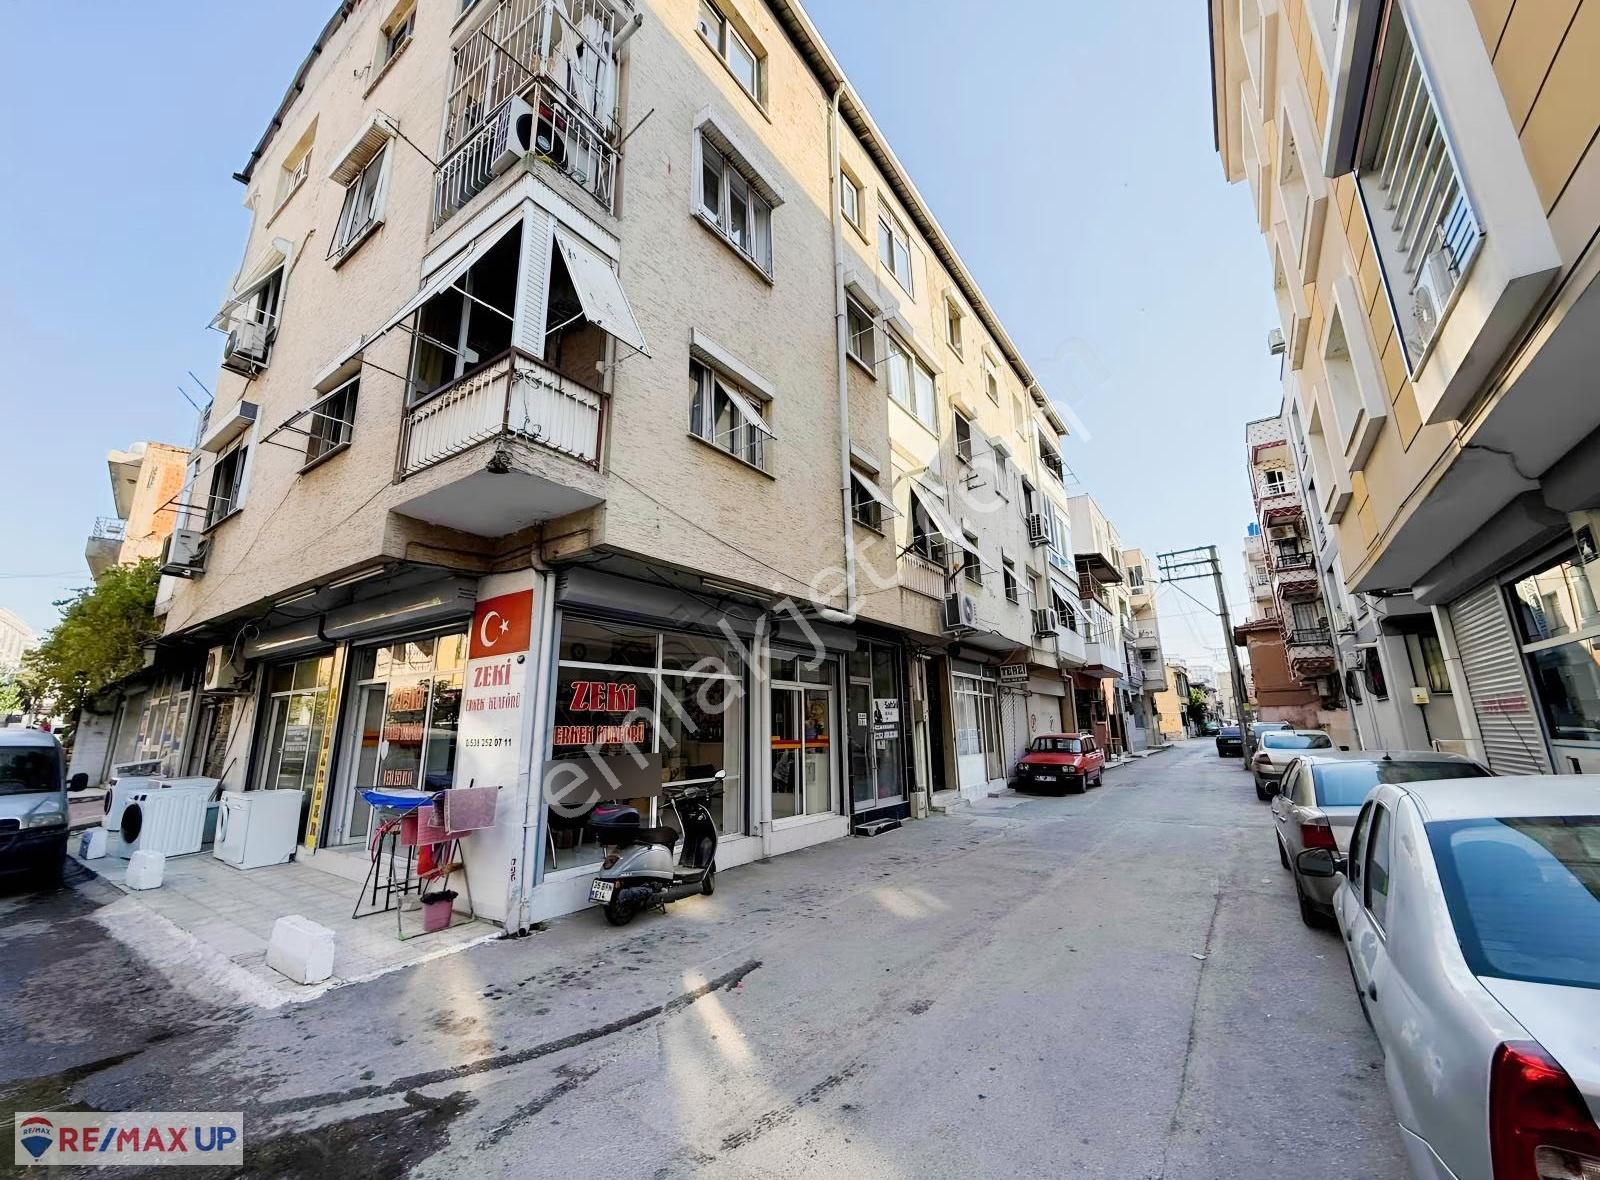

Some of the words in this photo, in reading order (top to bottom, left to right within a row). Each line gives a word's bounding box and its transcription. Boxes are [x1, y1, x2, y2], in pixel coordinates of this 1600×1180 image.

[473, 657, 512, 688] ZEKİ
[494, 738, 503, 748] 07
[504, 738, 512, 747] 11
[553, 725, 595, 746] ERKEK
